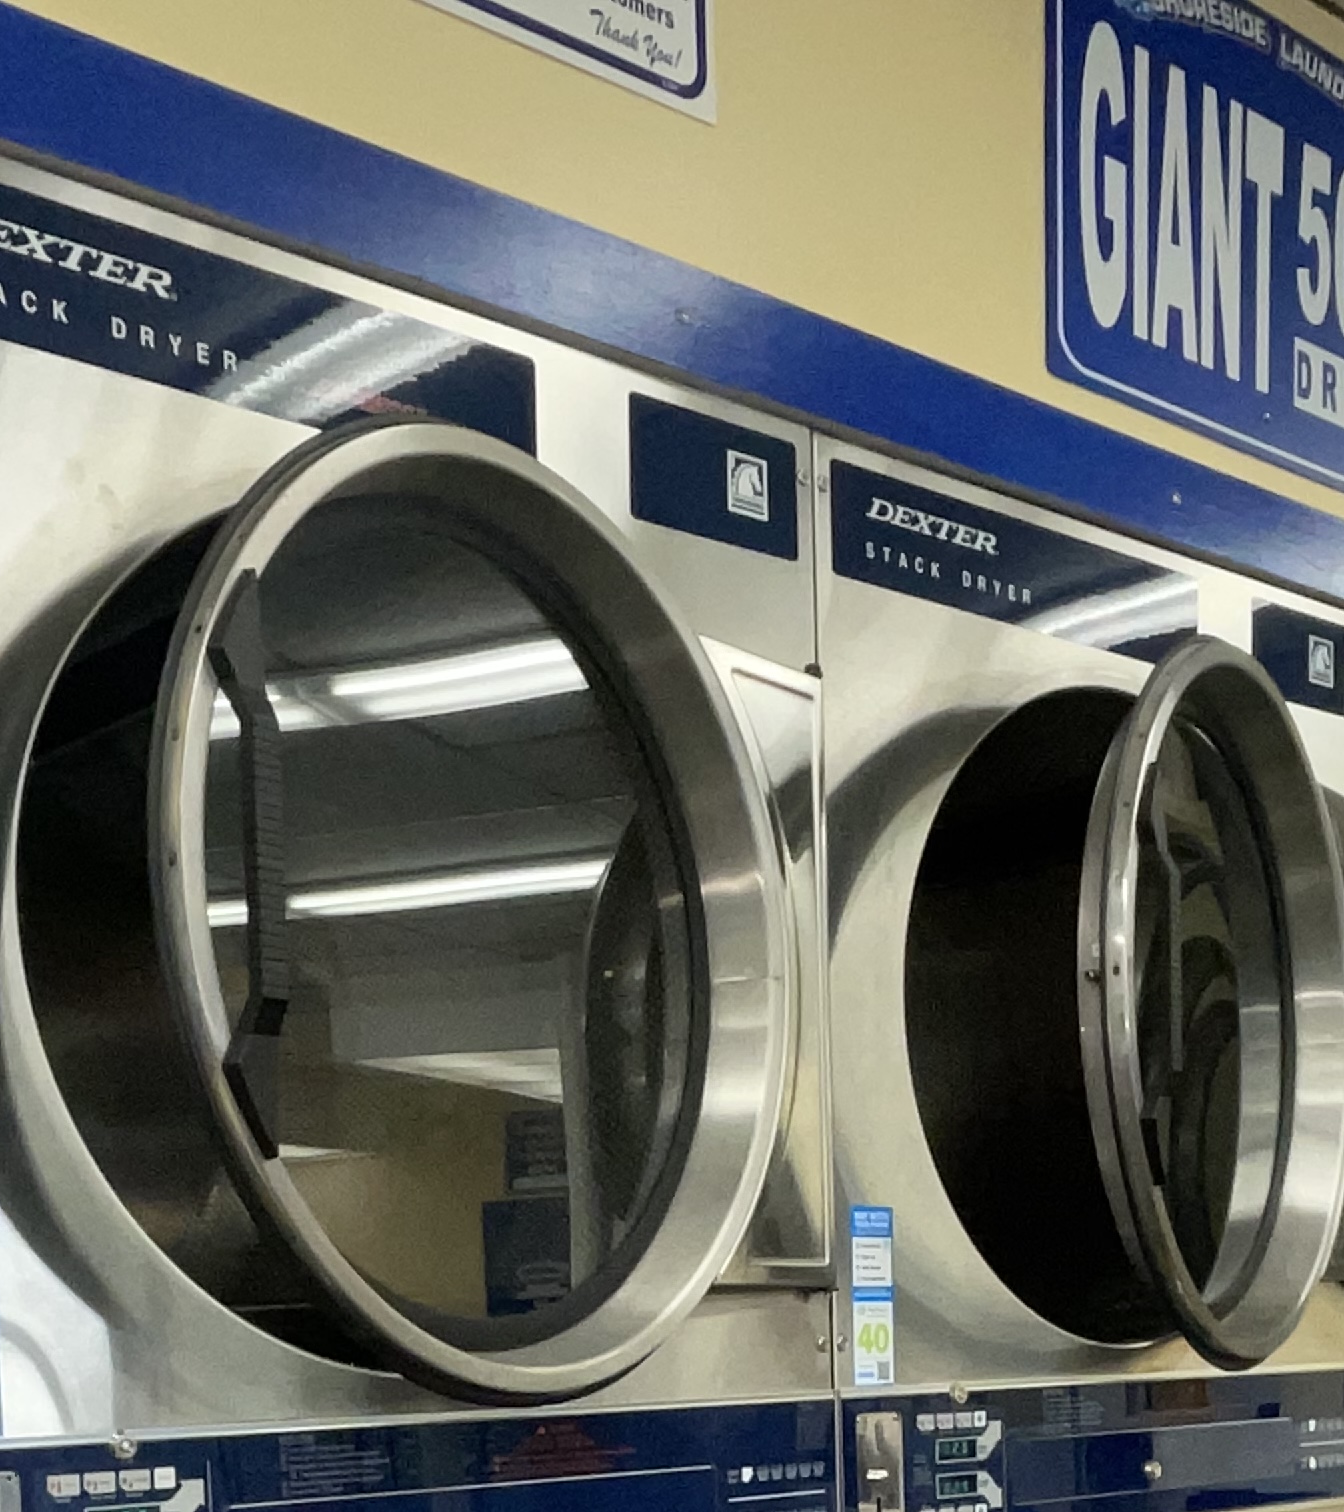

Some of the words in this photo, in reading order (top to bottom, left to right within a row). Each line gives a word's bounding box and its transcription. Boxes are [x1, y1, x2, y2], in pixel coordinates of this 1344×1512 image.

[590, 9, 640, 51] Thank
[643, 35, 682, 68] You!
[1079, 20, 1286, 396] GIANT
[109, 316, 241, 374] DRYER
[865, 497, 999, 556] DEXTER
[864, 541, 942, 579] STACK
[961, 570, 1033, 604] DRYER
[856, 1322, 891, 1354] 40
